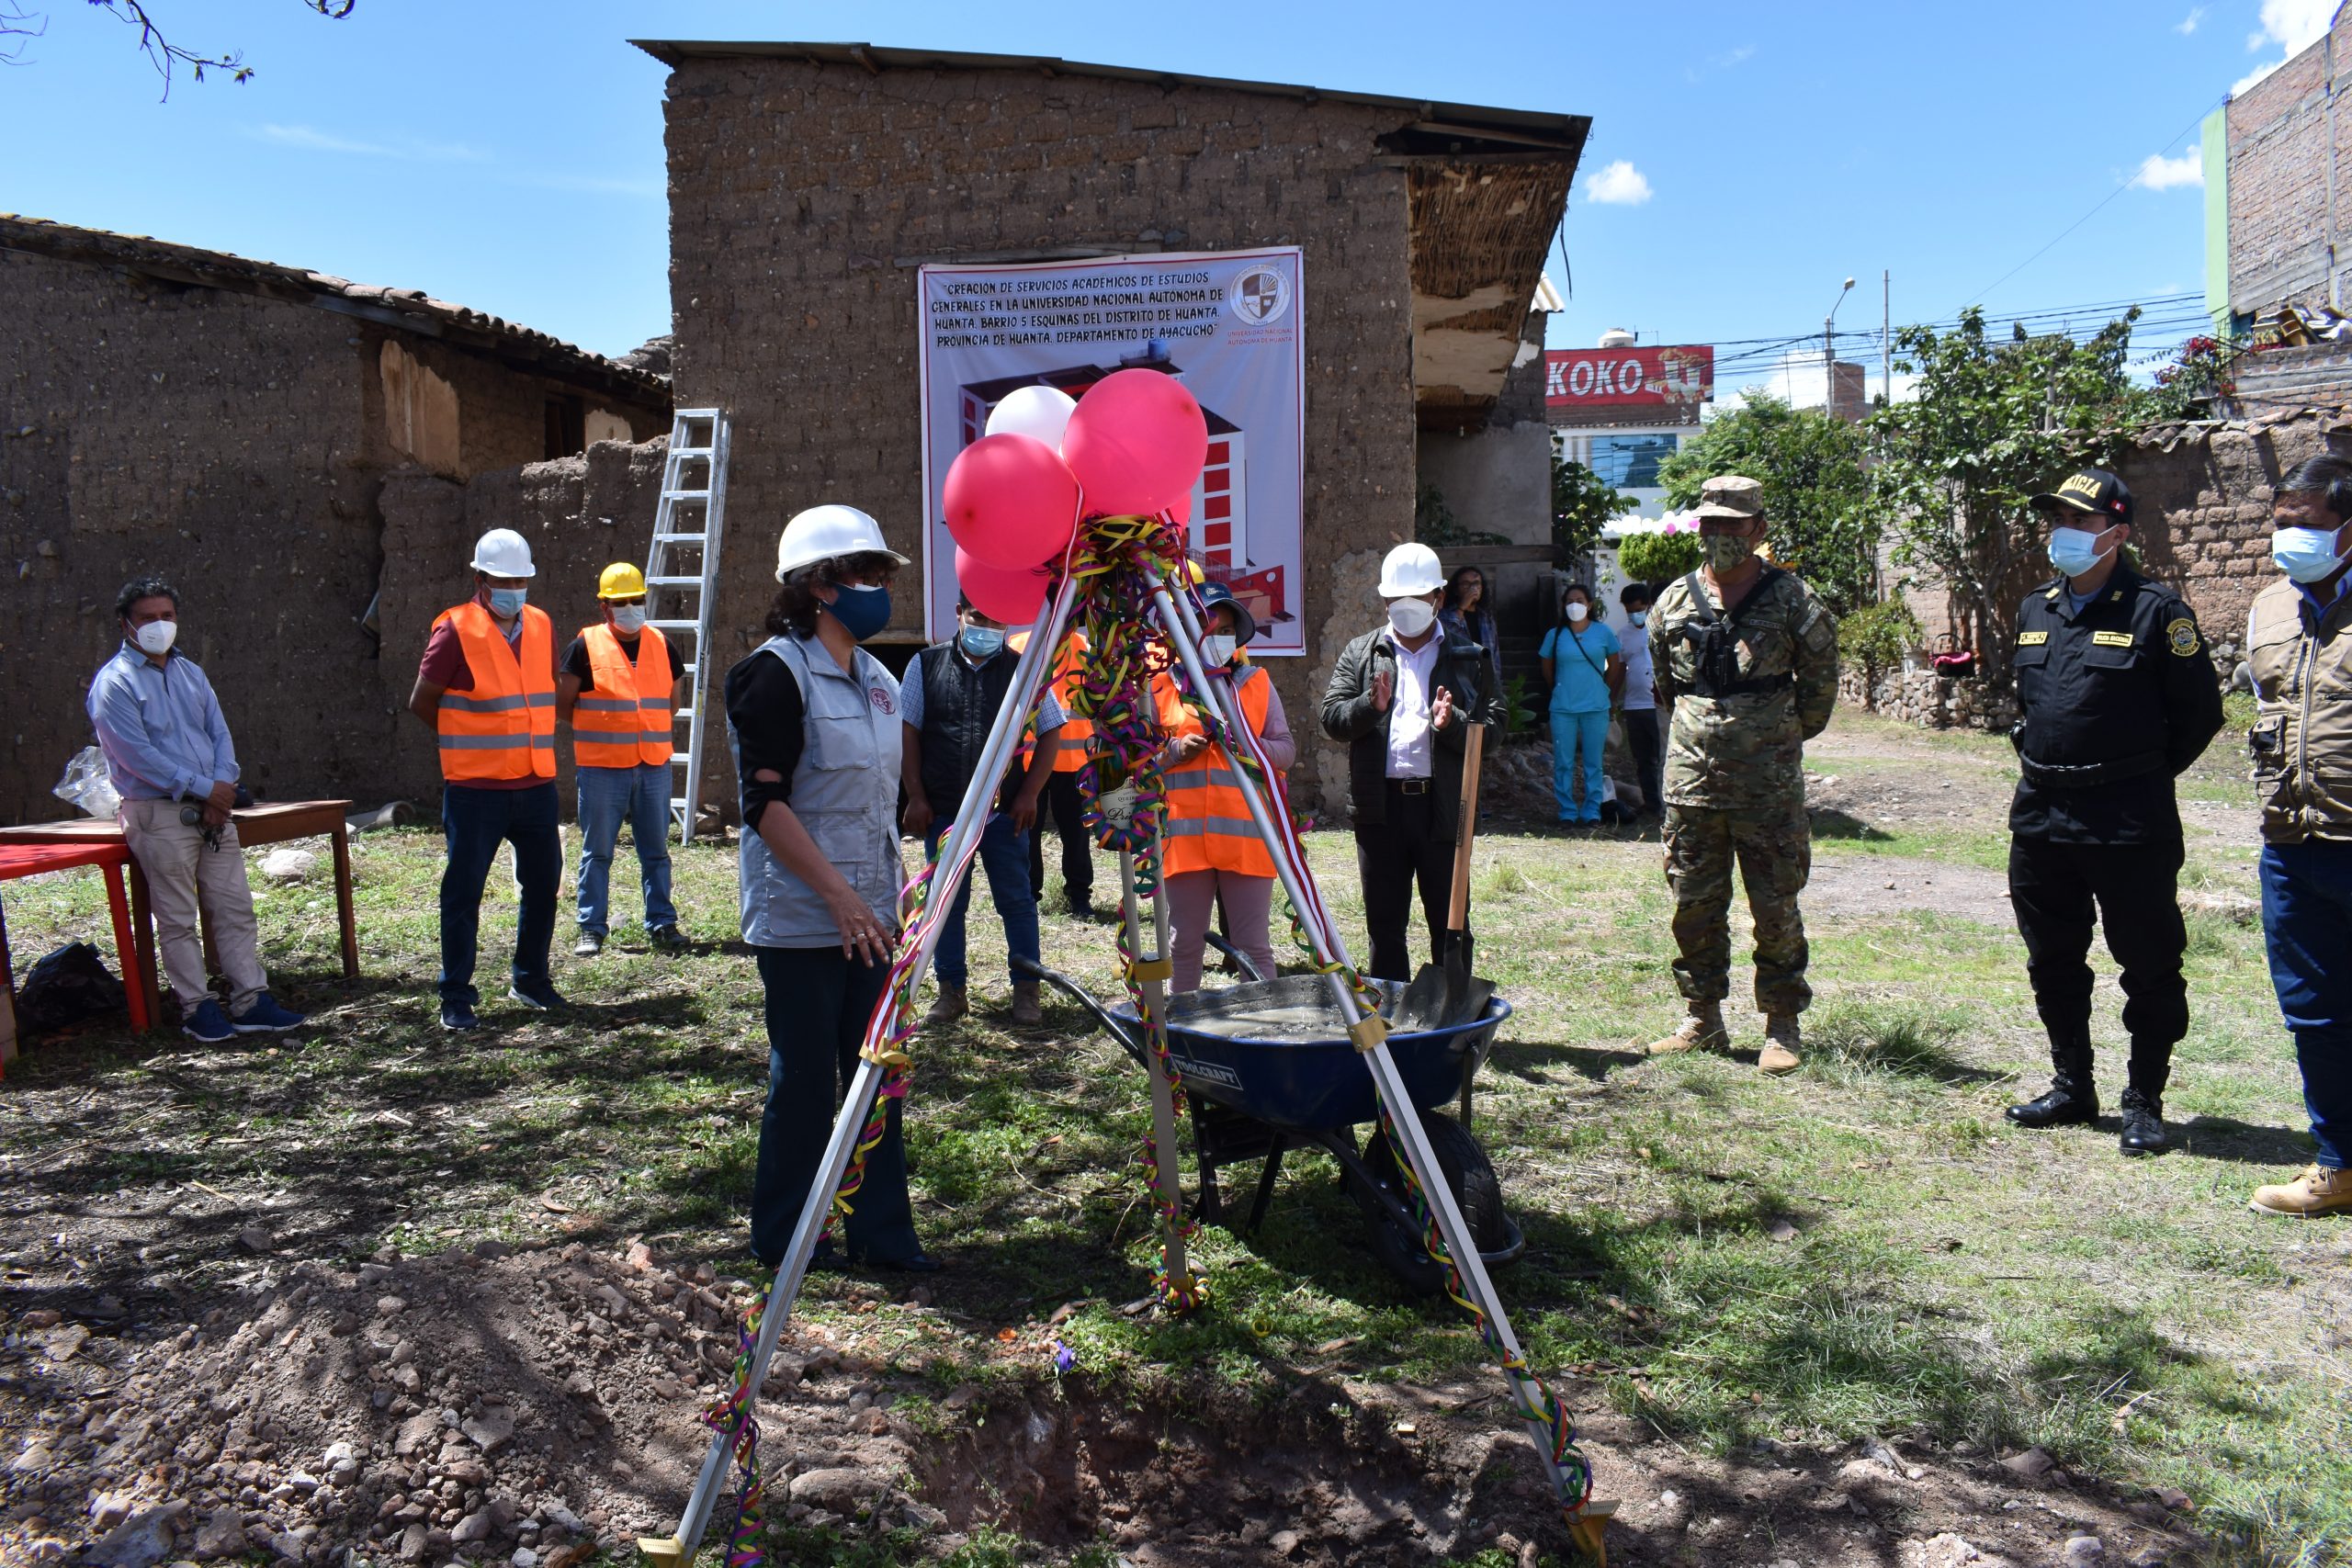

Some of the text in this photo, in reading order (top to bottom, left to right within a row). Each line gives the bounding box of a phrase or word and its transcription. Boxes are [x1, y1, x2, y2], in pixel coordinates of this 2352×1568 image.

[1001, 282, 1012, 293] DE
[1016, 279, 1069, 292] SERVICIOS
[1141, 276, 1154, 287] DE
[1159, 272, 1209, 286] ESTUDIOS
[932, 300, 986, 313] GENERALES
[989, 299, 1002, 311] EN
[1006, 299, 1019, 310] LA
[1023, 295, 1089, 310] UNIVERSIDAD
[1093, 292, 1145, 307] NACIONAL
[1210, 288, 1224, 301] DE
[980, 316, 1017, 329] BARRIO
[1022, 316, 1027, 327] 5
[1031, 313, 1080, 327] ESQUINAS
[1083, 311, 1102, 324] DEL
[1105, 310, 1154, 323] DISTRITO
[1158, 309, 1171, 321] DE
[937, 334, 989, 347] PROVINCIA
[993, 334, 1006, 345] DE
[1057, 328, 1137, 343] DEPARTAMENTO
[1142, 327, 1155, 339] DE
[1227, 329, 1263, 337] UNIVERSIDAD
[1545, 359, 1644, 397] KOKO
[1108, 807, 1133, 820] Pri
[1175, 1059, 1235, 1083] TOOLCRAFT
